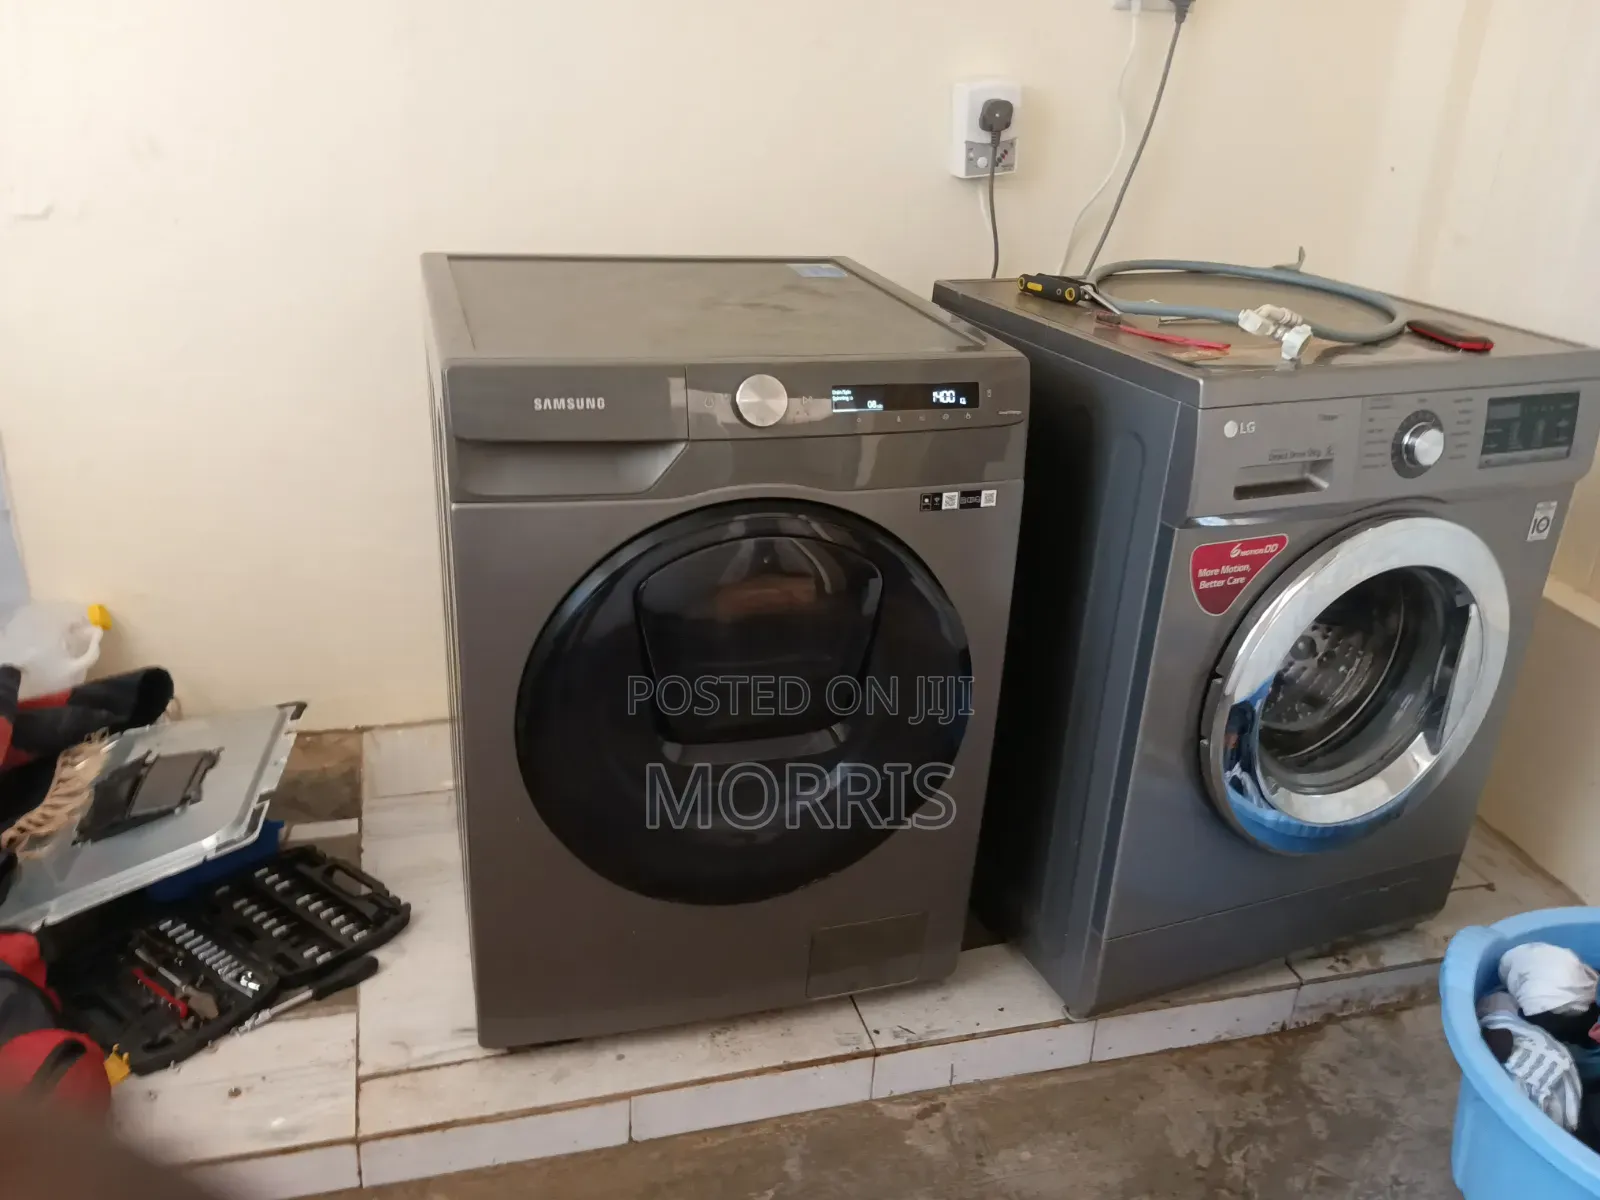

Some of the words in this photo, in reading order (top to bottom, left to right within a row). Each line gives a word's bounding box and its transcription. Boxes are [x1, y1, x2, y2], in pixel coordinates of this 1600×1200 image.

[533, 396, 606, 411] SAMSUNG
[1240, 421, 1256, 434] LG
[1198, 568, 1219, 578] More
[1220, 564, 1251, 575] Motion,
[1199, 580, 1225, 590] Better
[1227, 576, 1246, 586] Care
